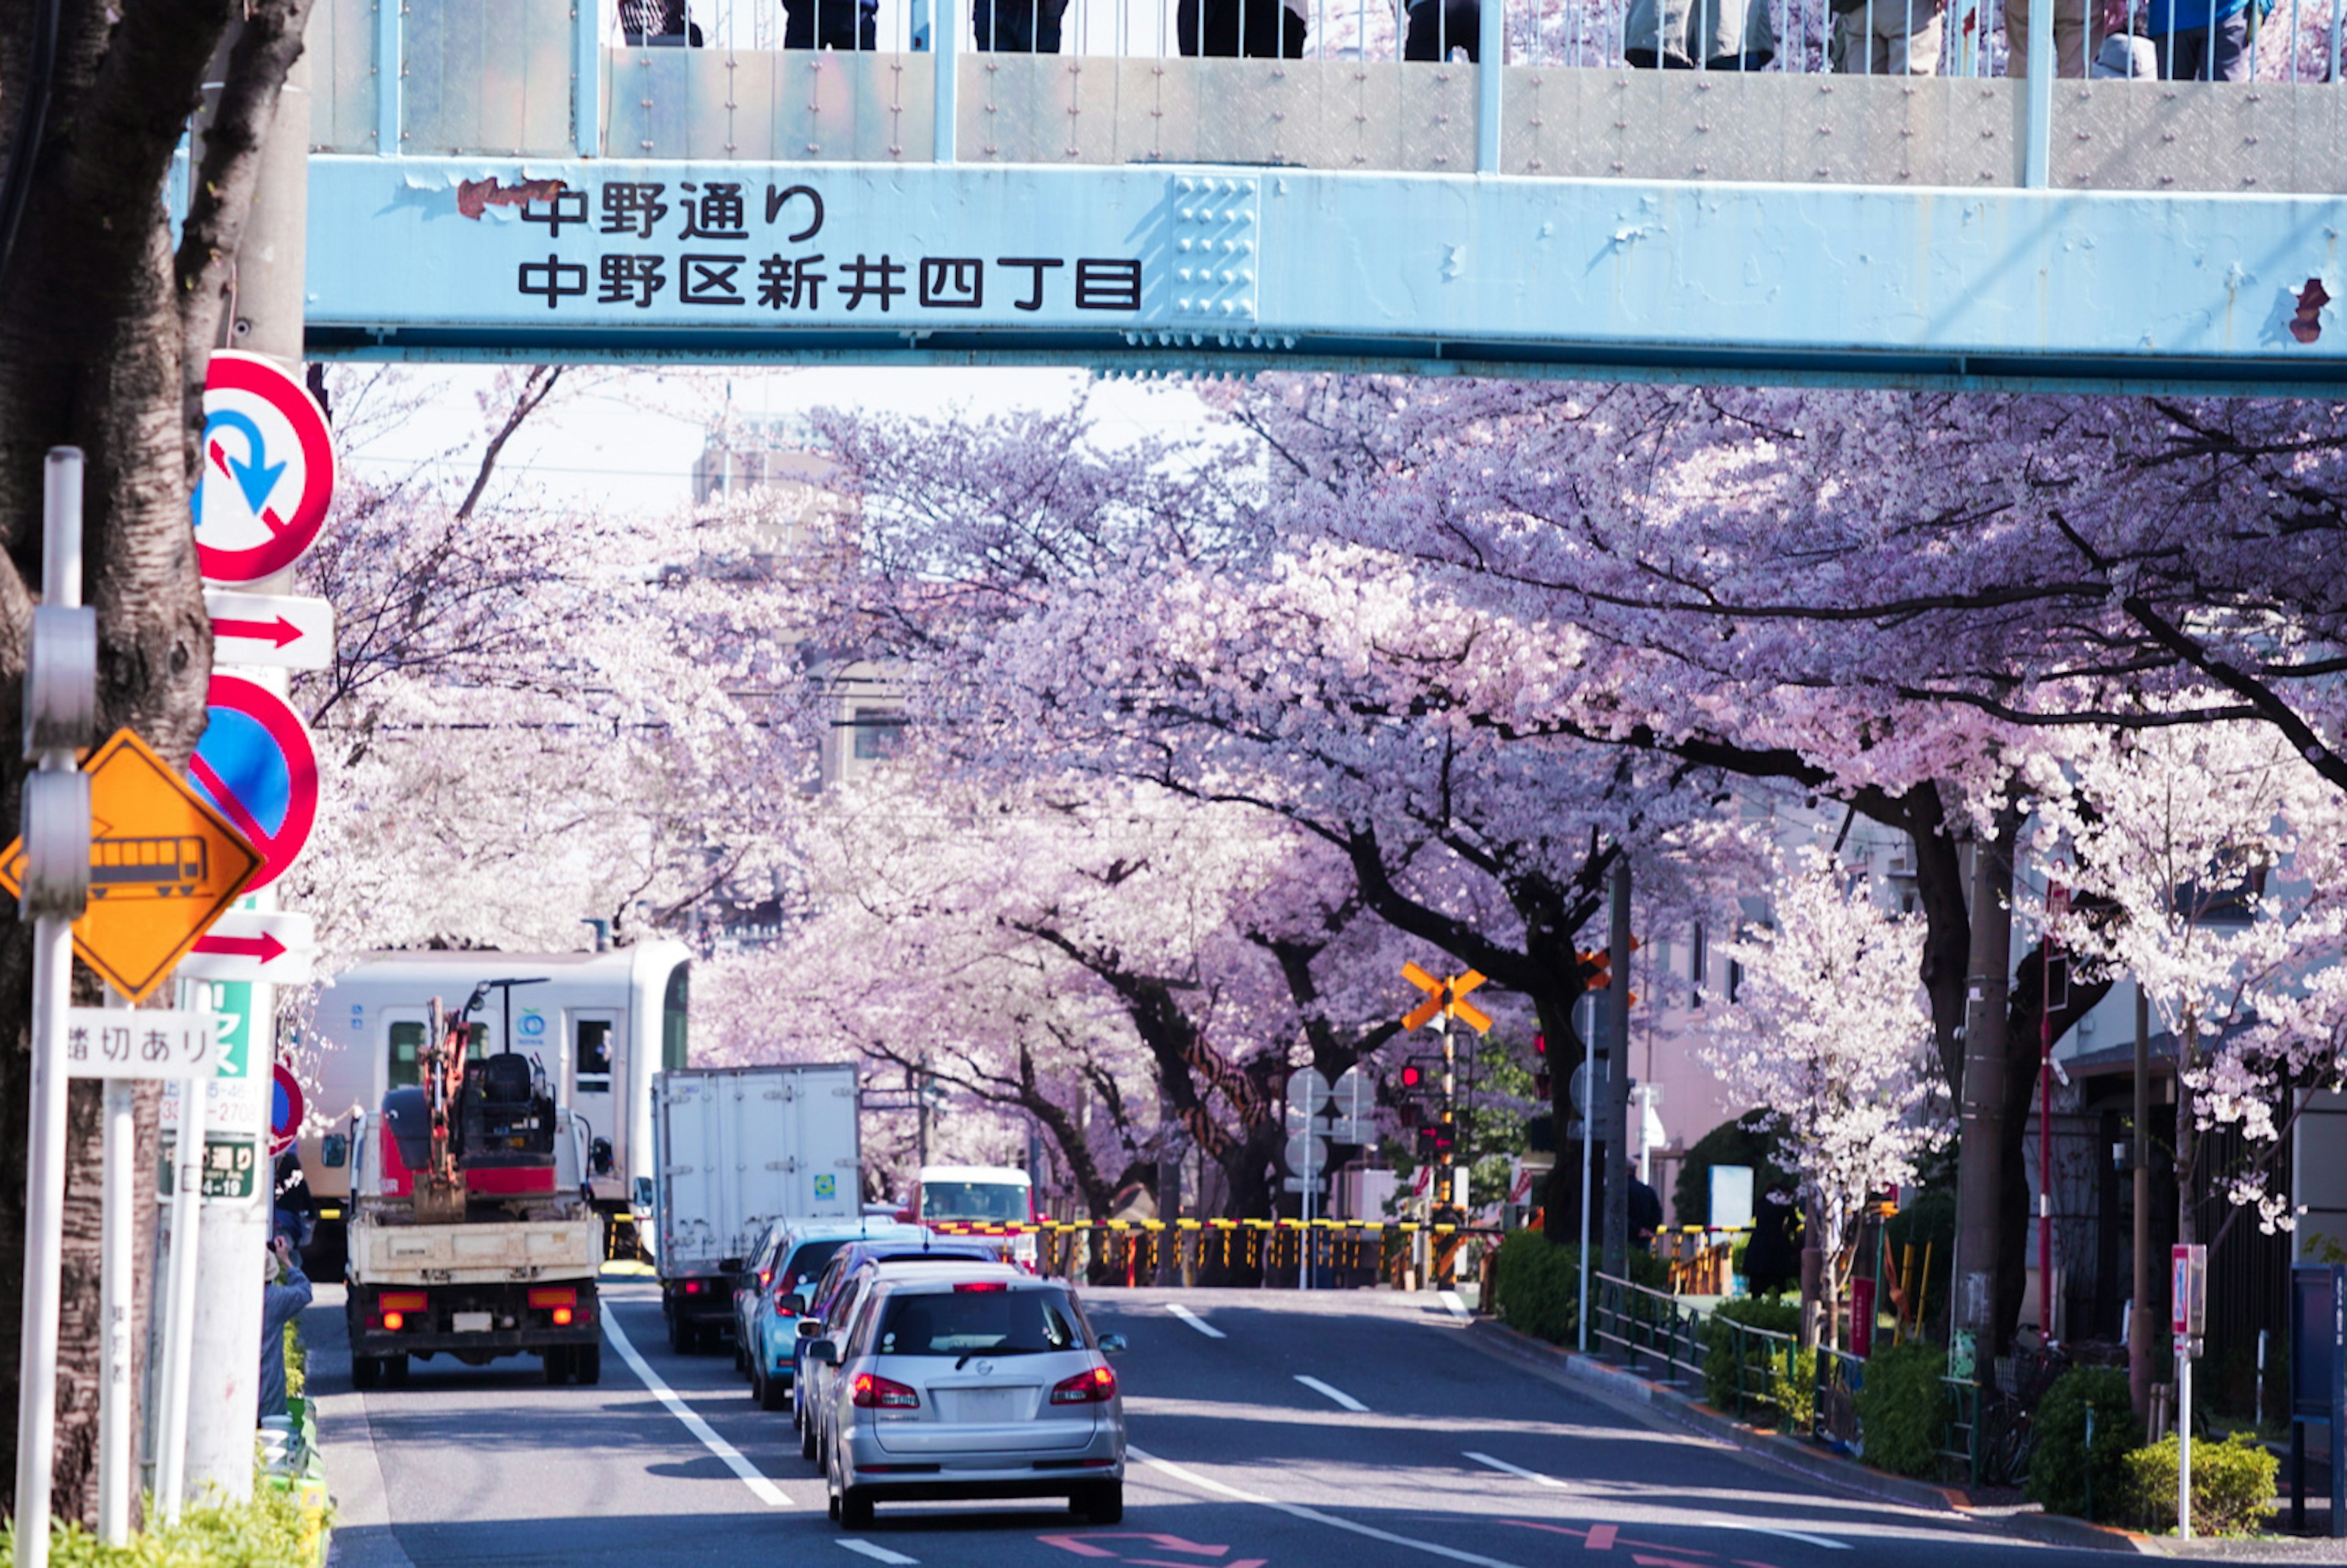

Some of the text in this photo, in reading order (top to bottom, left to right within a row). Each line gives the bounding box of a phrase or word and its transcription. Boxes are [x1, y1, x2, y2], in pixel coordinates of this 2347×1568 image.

[520, 182, 825, 243] 中野通り
[518, 253, 1142, 312] 中野区新井四丁目
[67, 1026, 206, 1063] 踏切あり
